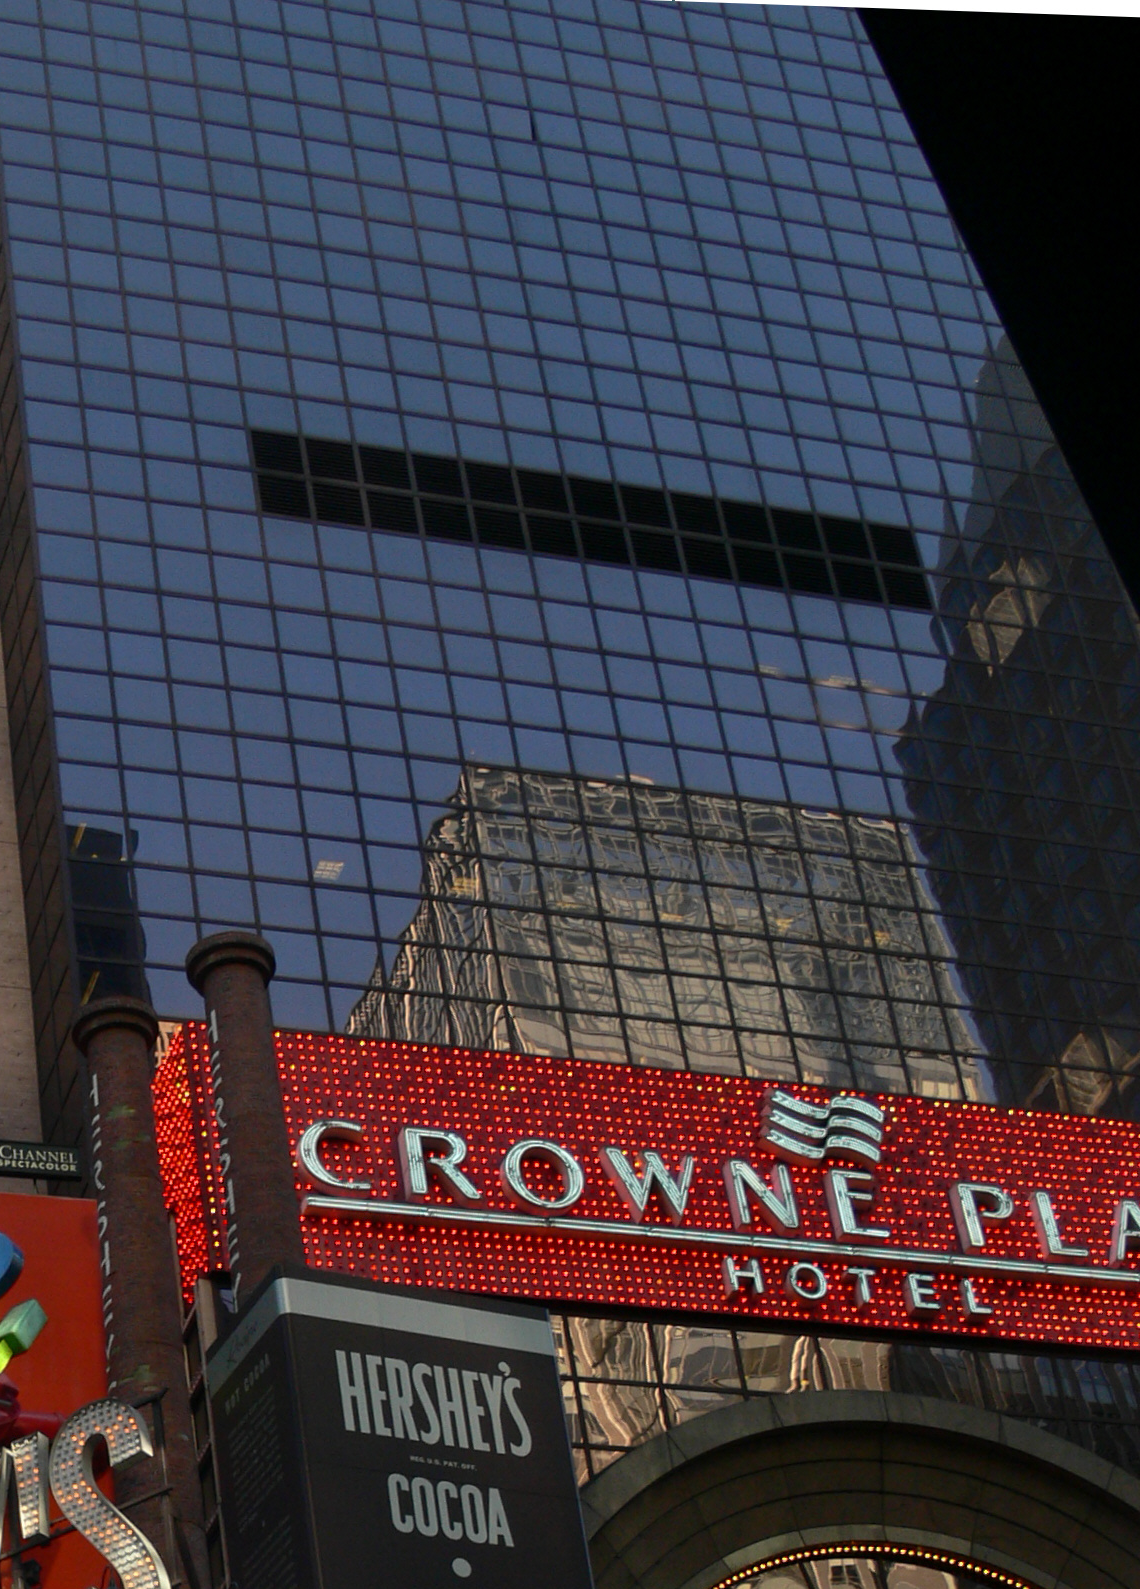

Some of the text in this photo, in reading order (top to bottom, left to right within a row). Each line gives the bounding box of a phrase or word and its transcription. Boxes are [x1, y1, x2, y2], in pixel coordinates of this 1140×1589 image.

[295, 1118, 891, 1243] CROWNE
[722, 1257, 993, 1319] HOTEL
[334, 1350, 532, 1457] HERSHEY'S
[387, 1473, 515, 1547] COCOA
